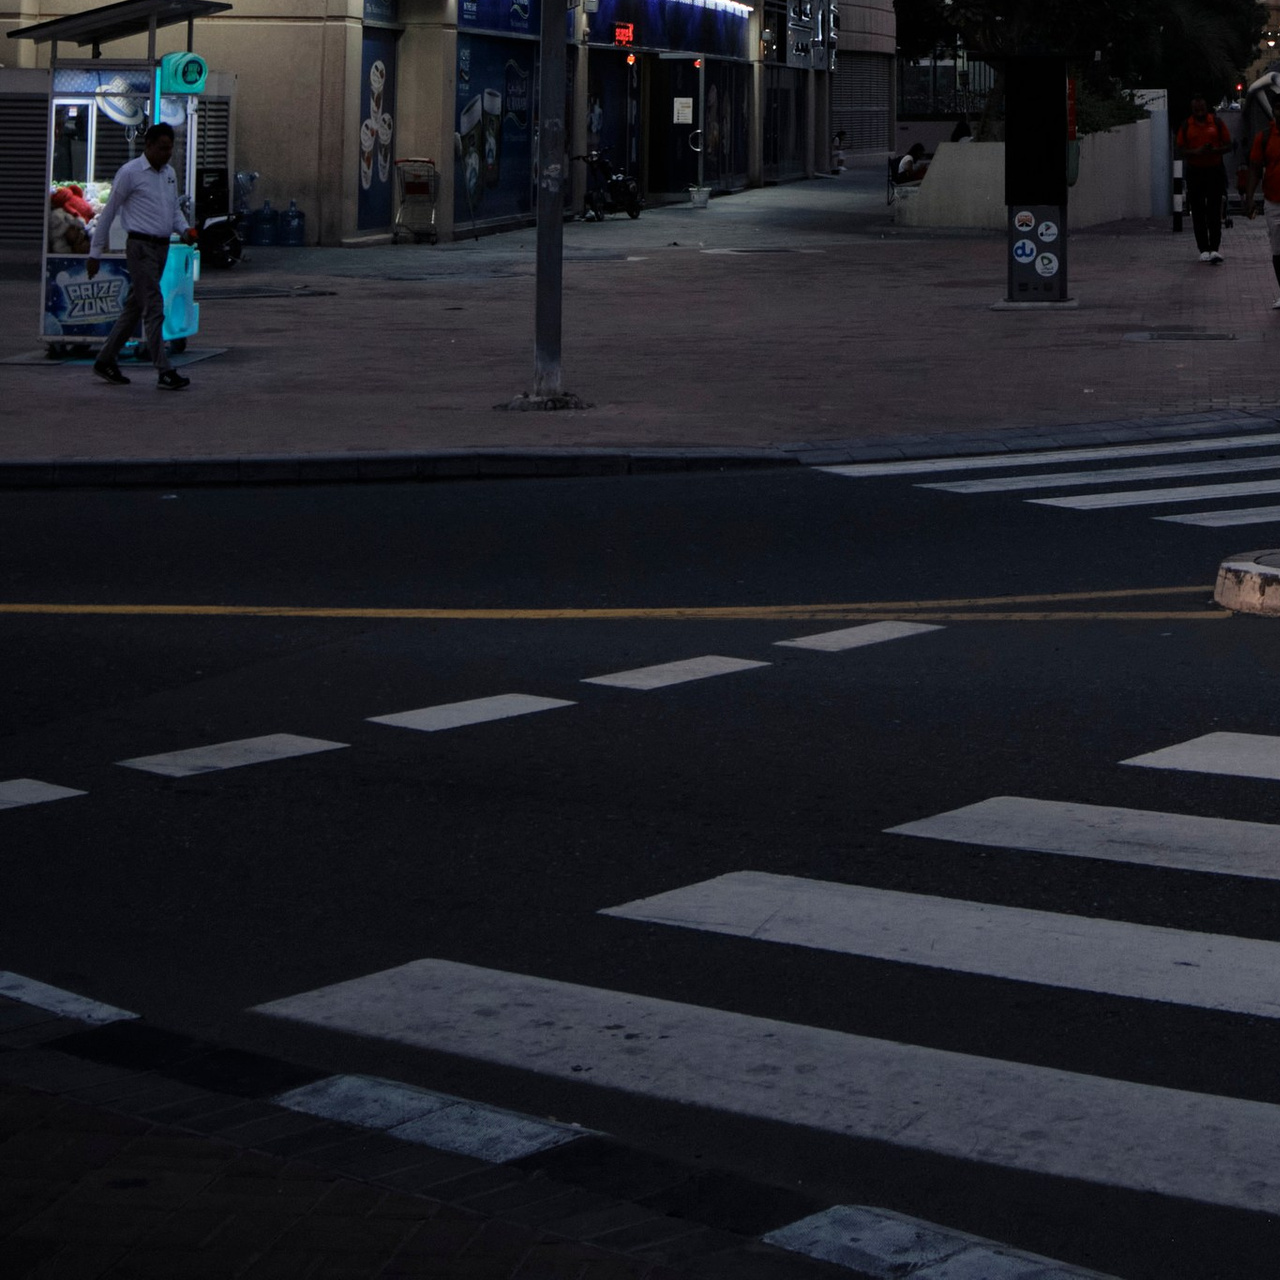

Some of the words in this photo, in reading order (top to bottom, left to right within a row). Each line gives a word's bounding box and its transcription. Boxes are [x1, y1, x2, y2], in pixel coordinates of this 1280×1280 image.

[1014, 241, 1034, 258] du
[66, 281, 121, 301] PRIZE
[70, 297, 119, 316] ZONE
